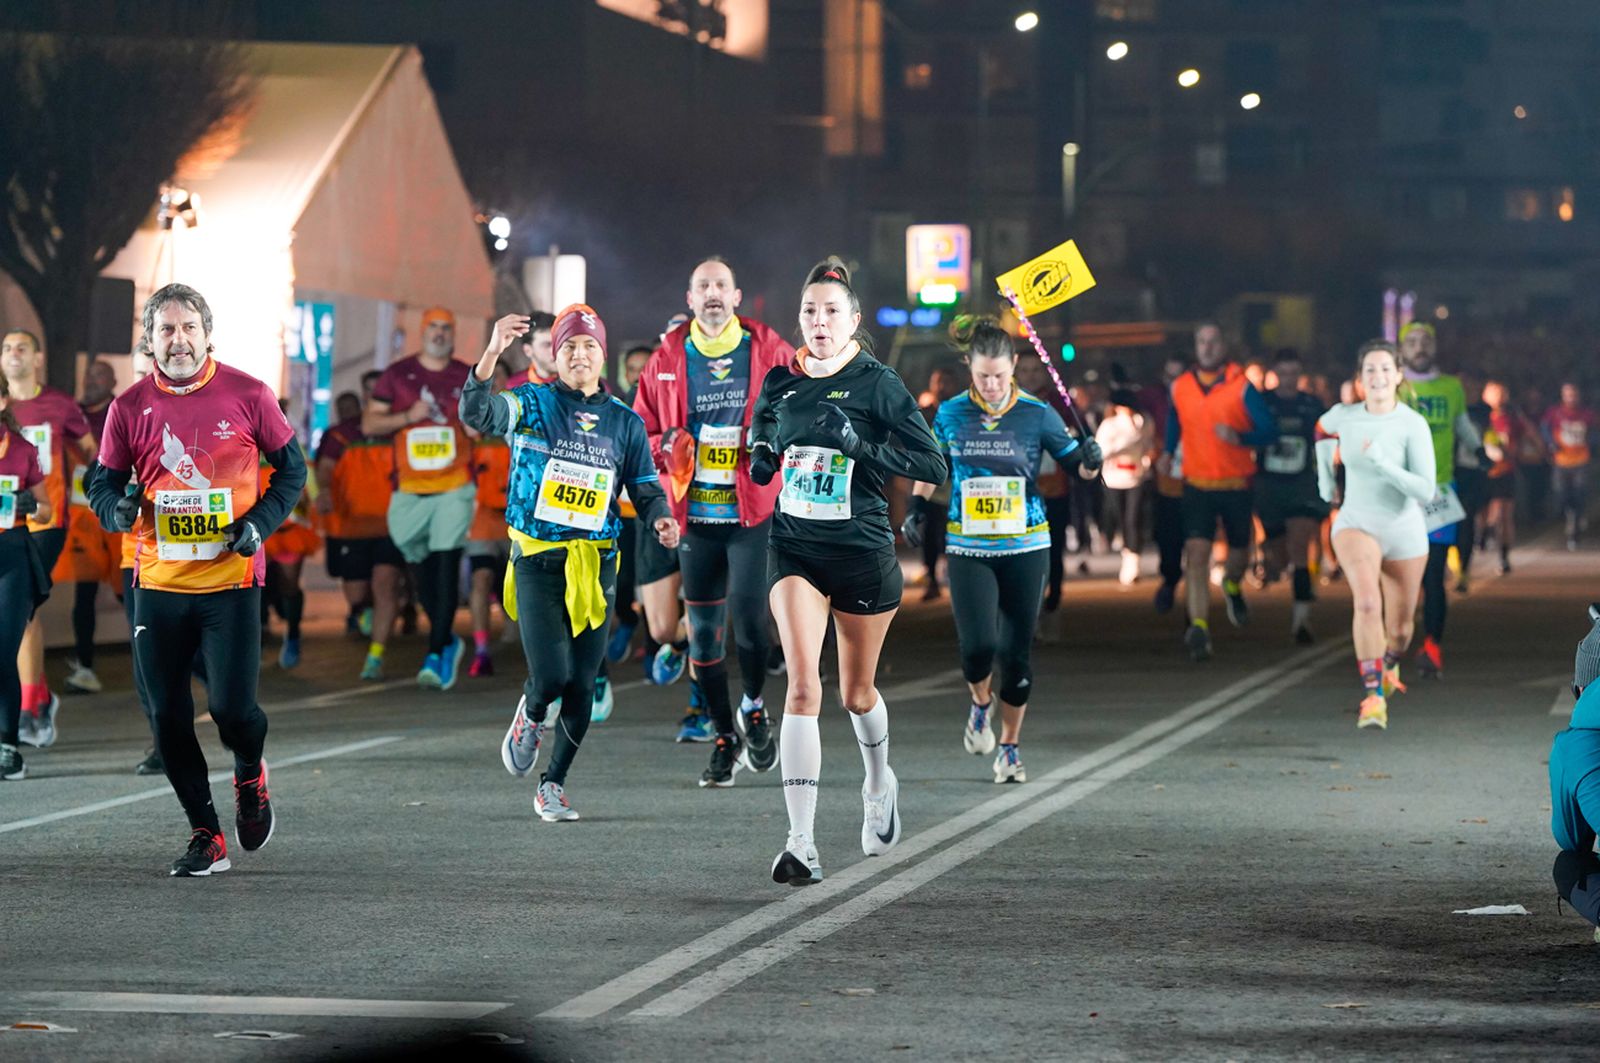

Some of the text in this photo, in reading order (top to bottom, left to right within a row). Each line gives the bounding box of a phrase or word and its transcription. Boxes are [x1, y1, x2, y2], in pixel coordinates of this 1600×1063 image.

[697, 390, 745, 403] PASOS QUE
[696, 403, 720, 412] DEJAN
[557, 439, 608, 457] PASOS QUE
[993, 441, 1010, 449] QUE
[553, 447, 611, 467] DEJAN HUELLA
[707, 448, 740, 464] 457
[176, 460, 193, 480] 43
[551, 474, 566, 482] SAN
[193, 497, 202, 505] DE
[553, 484, 597, 508] 4576
[975, 497, 1012, 514] 4574
[168, 515, 220, 536] 6384
